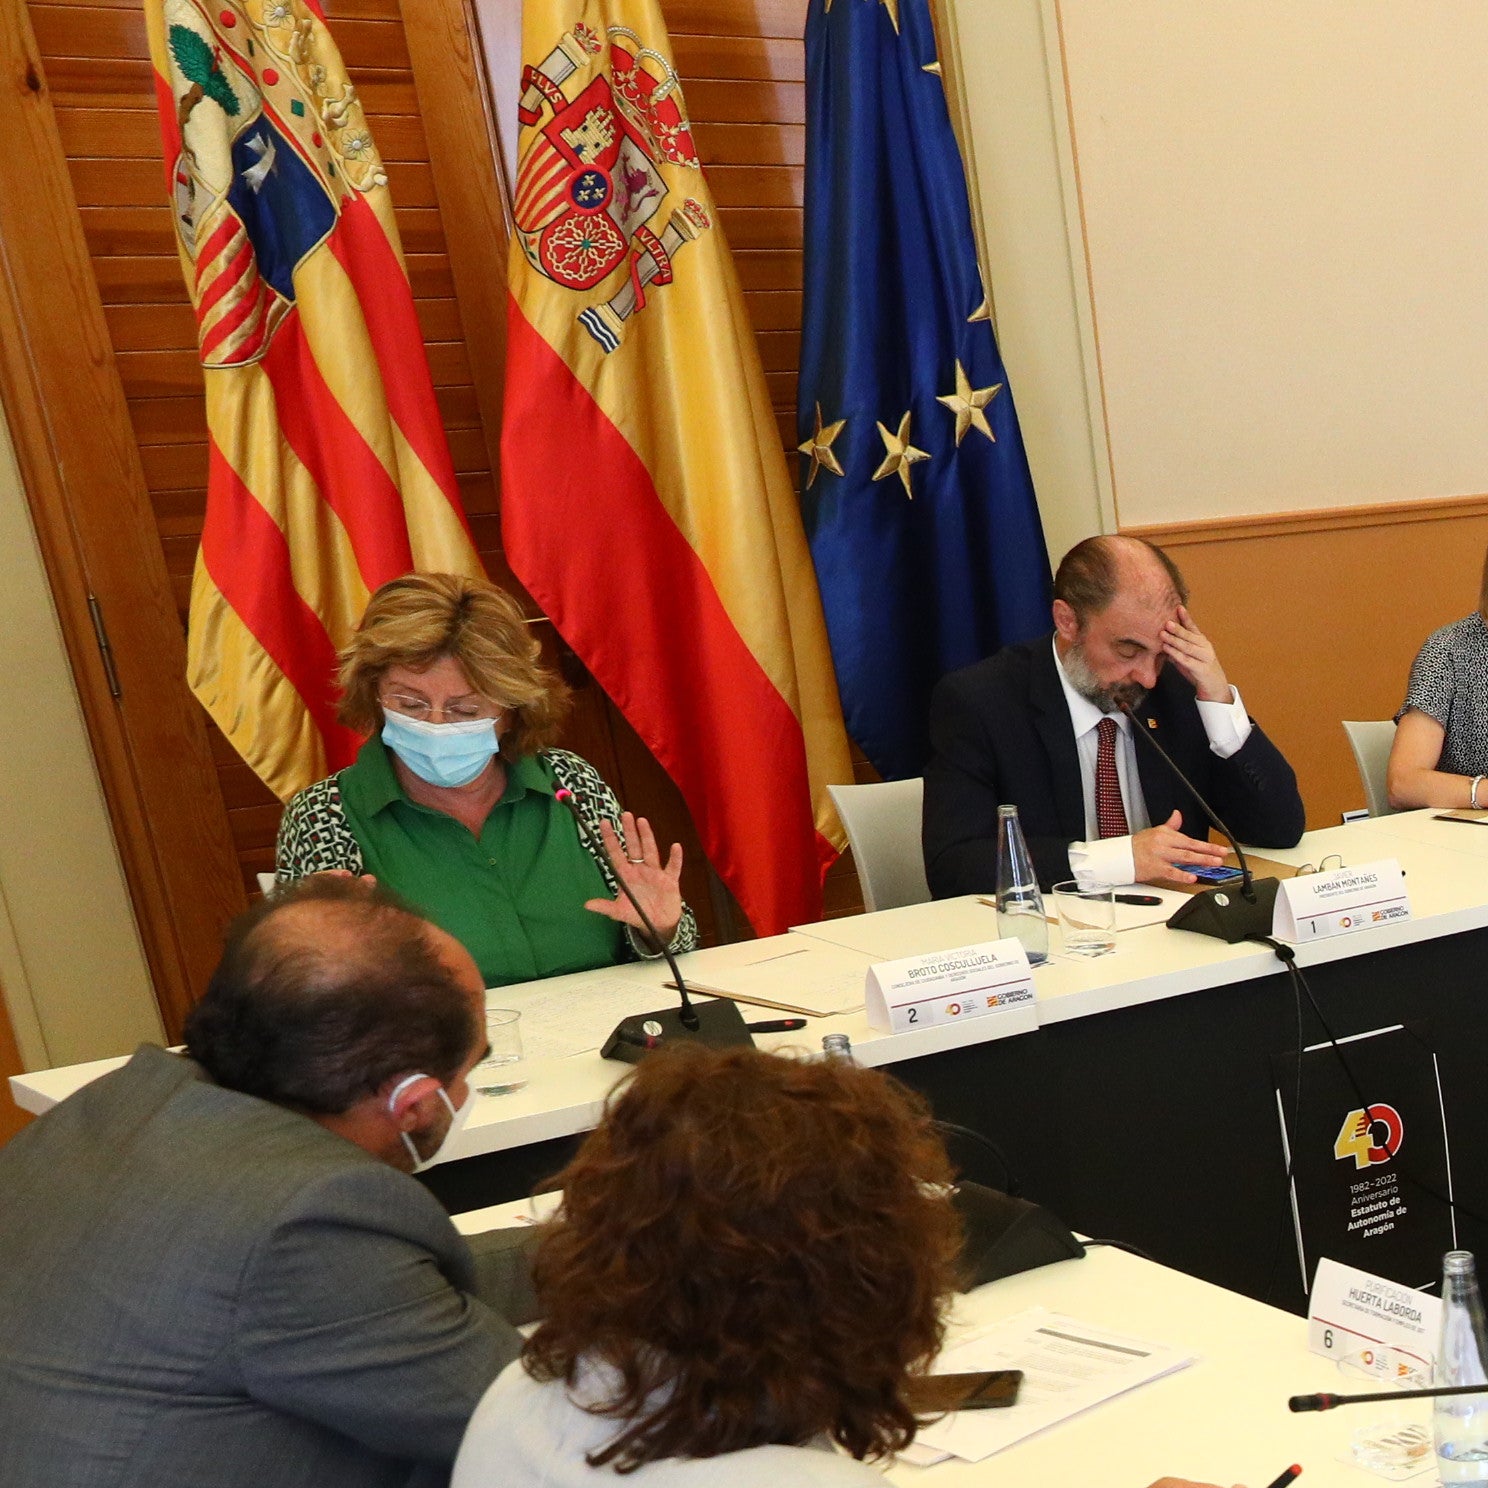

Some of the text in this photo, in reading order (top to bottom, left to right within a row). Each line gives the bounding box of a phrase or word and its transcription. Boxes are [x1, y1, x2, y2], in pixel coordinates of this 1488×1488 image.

[640, 229, 671, 281] VLTRA
[1311, 921, 1316, 934] 1
[908, 954, 998, 979] BROTO COSCULLUELA
[907, 1008, 918, 1024] 2
[1334, 1103, 1403, 1170] 40
[1350, 1173, 1397, 1194] 1982-2022
[1351, 1185, 1399, 1206] Aniversario
[1351, 1197, 1401, 1218] Estatuto de
[1347, 1206, 1407, 1232] Autonomía de
[1363, 1222, 1395, 1238] Aragón
[1349, 1288, 1422, 1323] HUERTA LABORDA
[1324, 1330, 1333, 1349] 6
